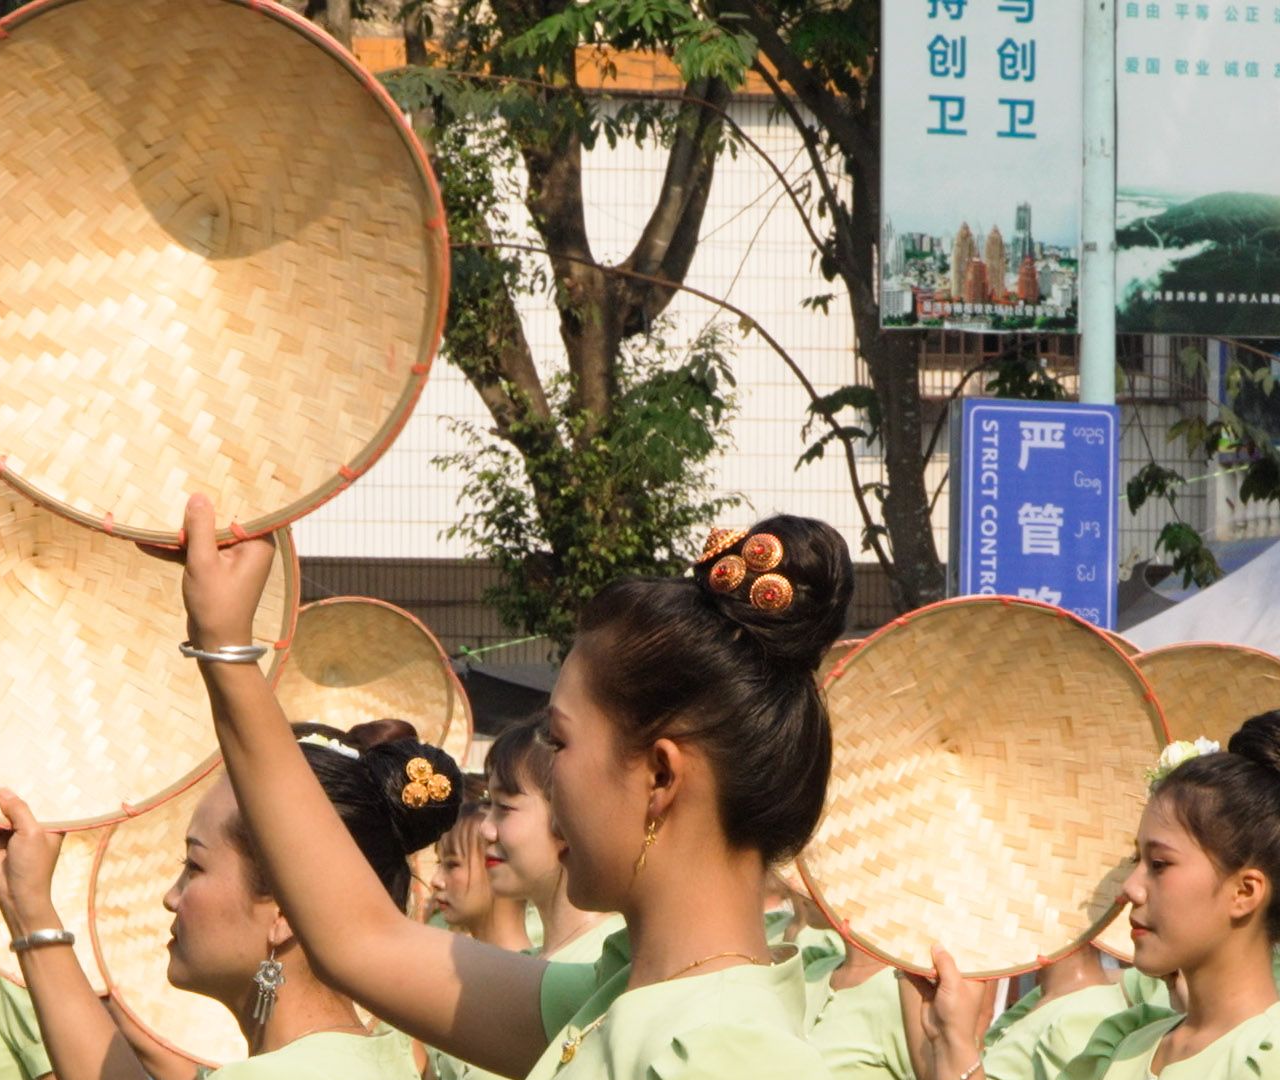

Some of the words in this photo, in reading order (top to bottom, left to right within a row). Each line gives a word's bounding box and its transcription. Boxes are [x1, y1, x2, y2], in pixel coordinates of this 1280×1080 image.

[1125, 2, 1160, 19] 自由
[1175, 3, 1209, 21] 平等
[1224, 6, 1259, 23] 公正
[1125, 57, 1160, 75] 爱国
[1175, 59, 1210, 76] 敬业
[1224, 60, 1259, 78] 诚信
[981, 420, 999, 499] STRICT
